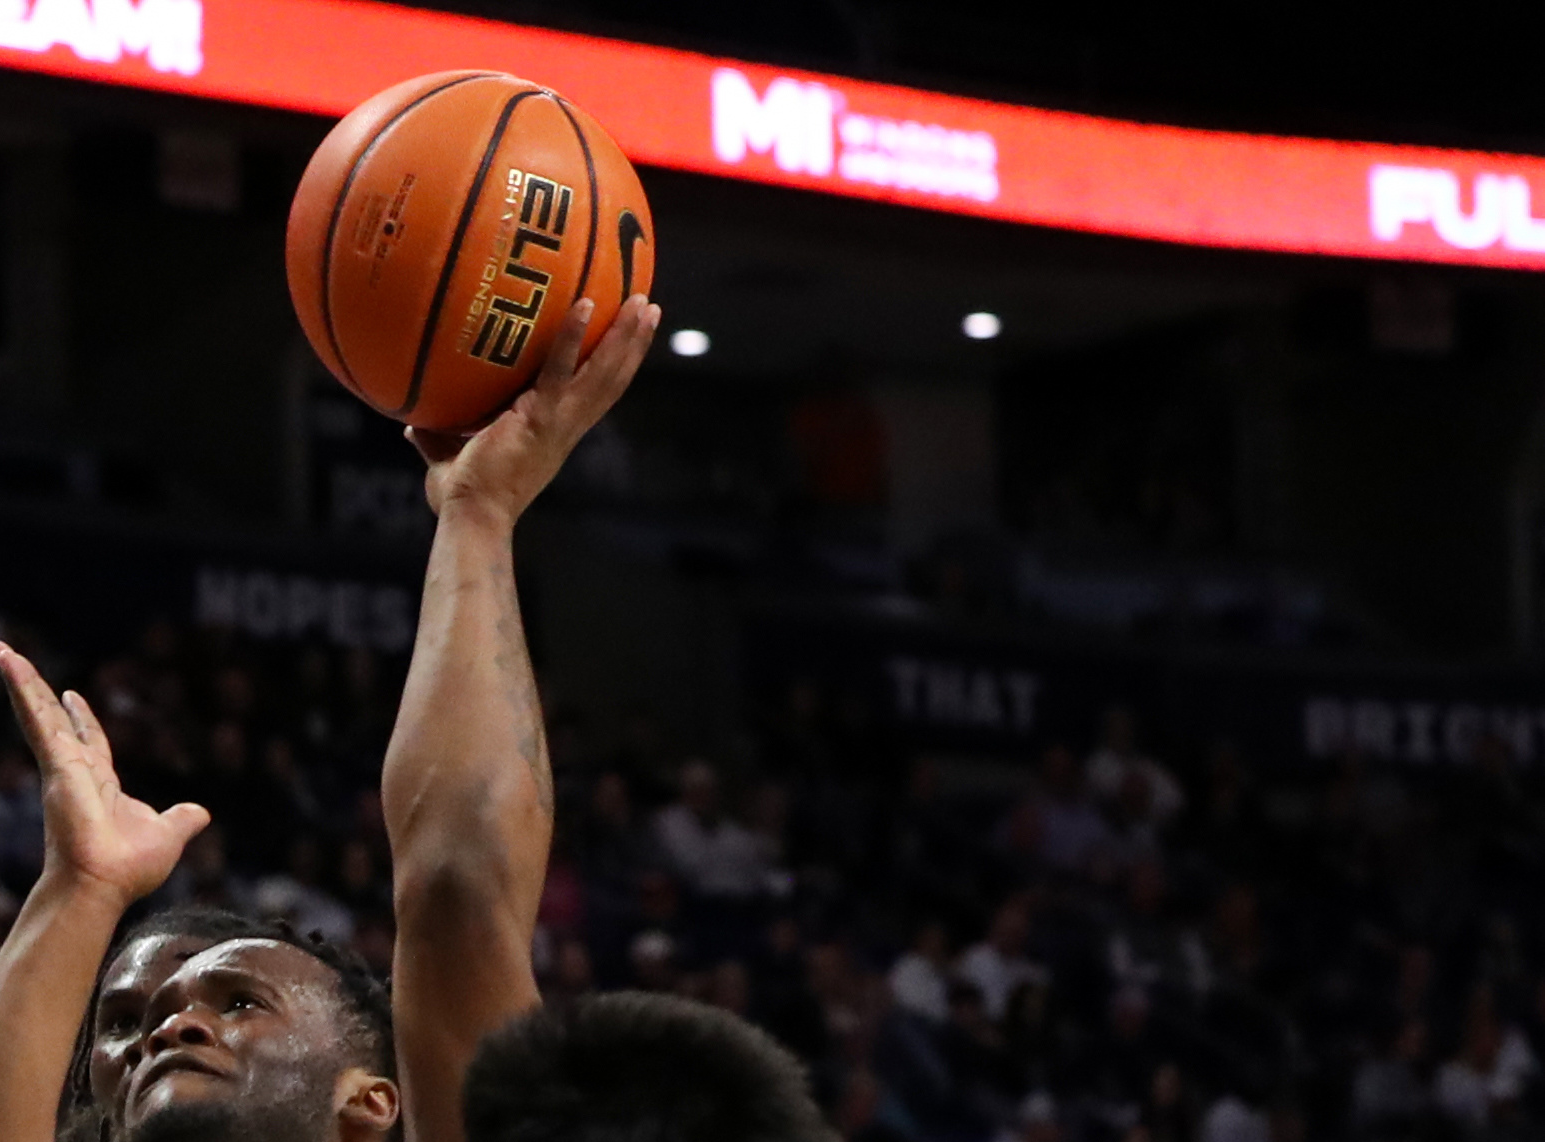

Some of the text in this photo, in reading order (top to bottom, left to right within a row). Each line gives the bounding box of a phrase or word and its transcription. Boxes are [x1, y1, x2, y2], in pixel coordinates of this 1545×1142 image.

[469, 172, 573, 368] ELITE
[194, 564, 413, 652] HOPES
[883, 655, 1043, 735] THAT
[1303, 697, 1545, 766] BRIGH
